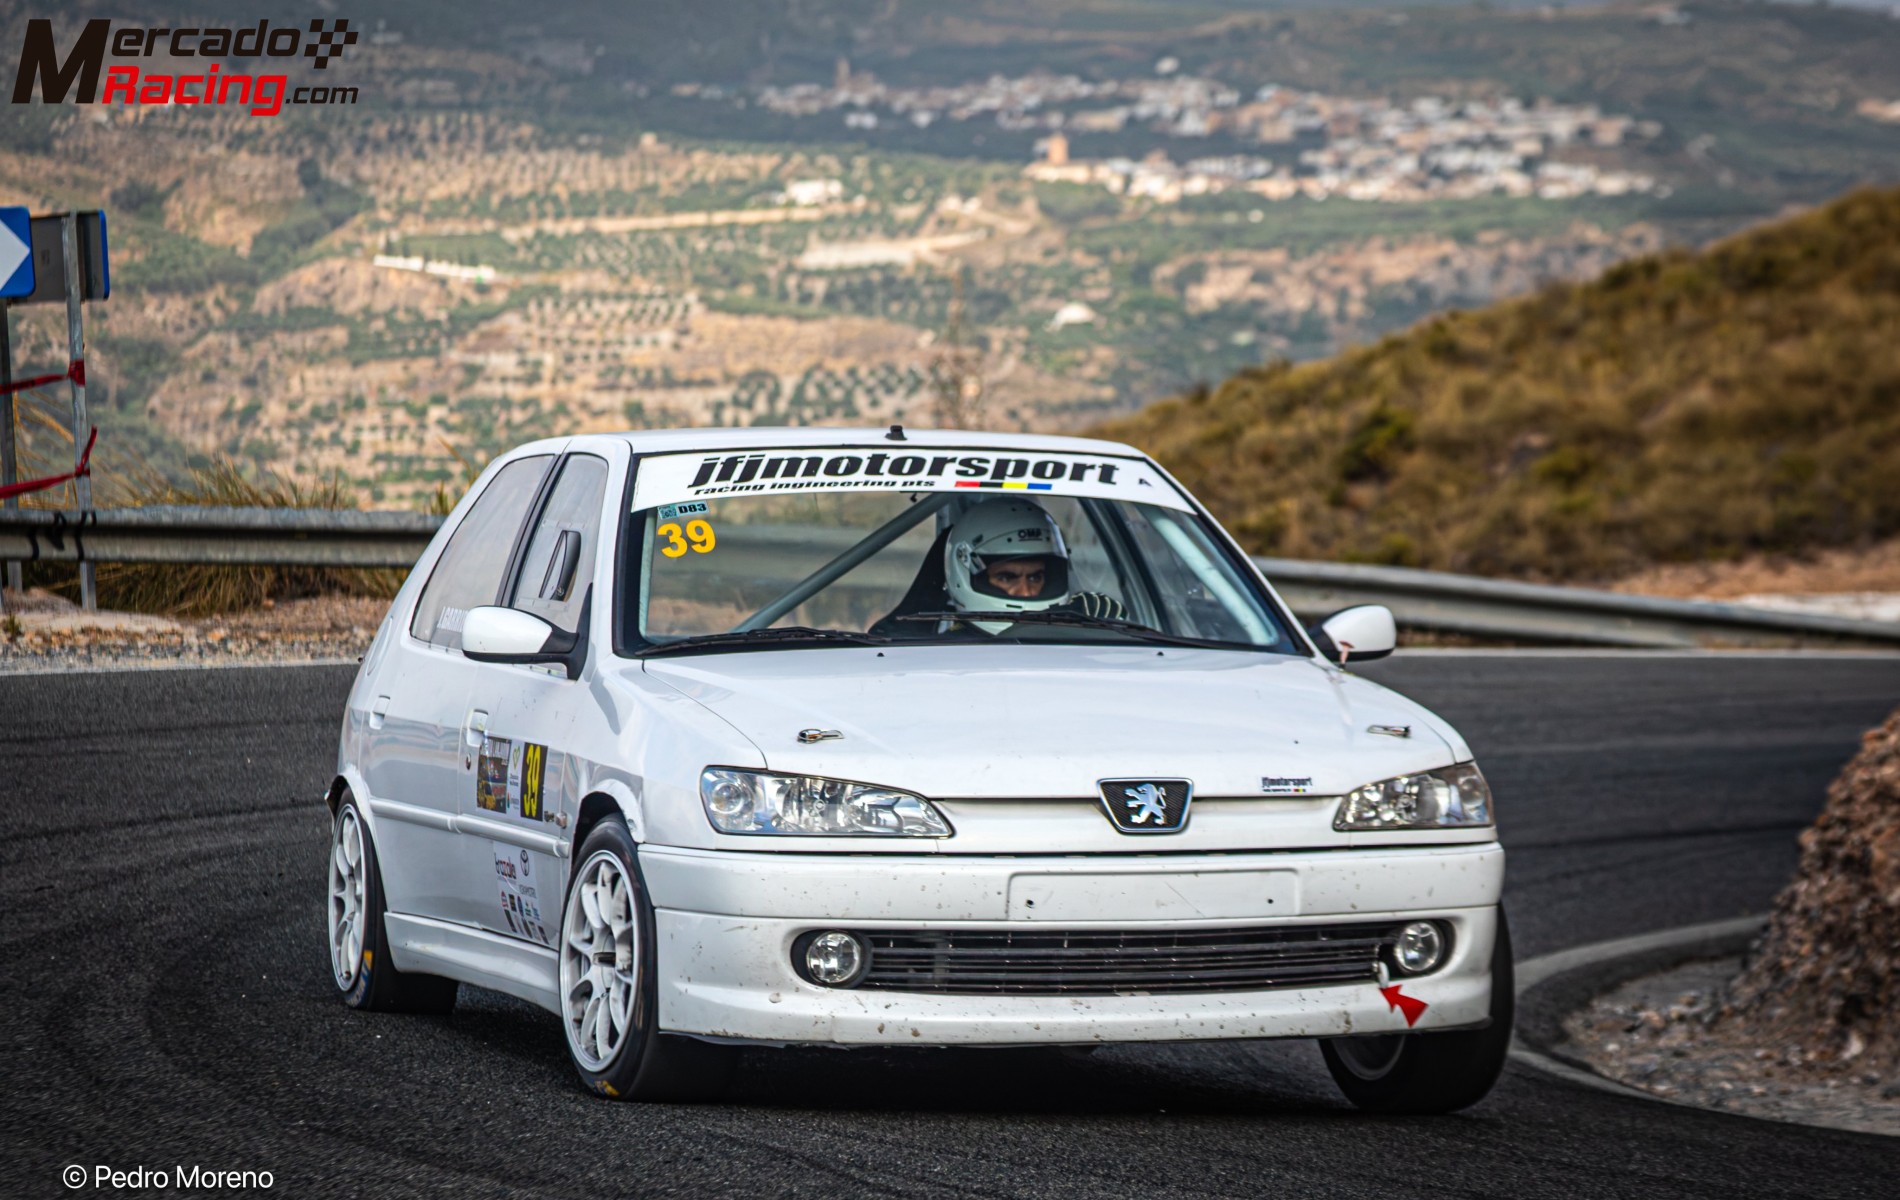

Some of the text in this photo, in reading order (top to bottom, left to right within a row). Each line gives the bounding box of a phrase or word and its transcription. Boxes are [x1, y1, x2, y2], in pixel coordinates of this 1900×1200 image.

[694, 484, 766, 496] racing
[657, 519, 716, 558] 39
[523, 743, 541, 818] 39
